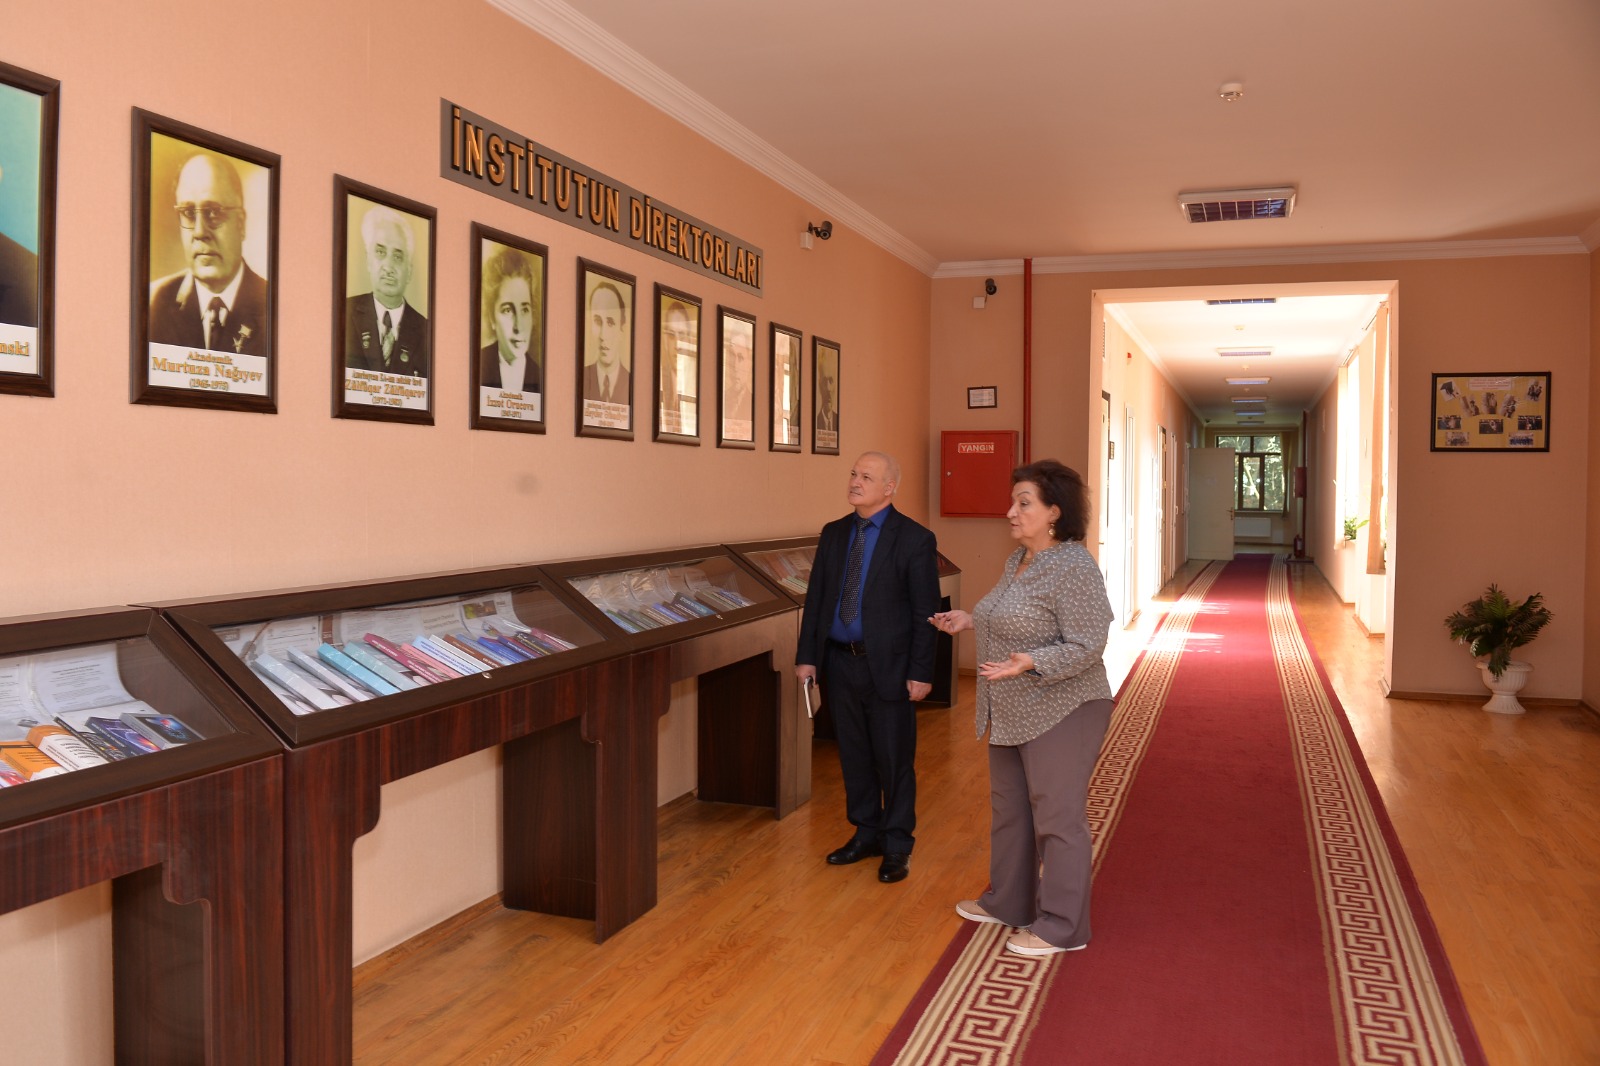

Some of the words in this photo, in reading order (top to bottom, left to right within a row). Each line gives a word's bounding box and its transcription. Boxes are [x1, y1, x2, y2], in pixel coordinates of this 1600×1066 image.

[450, 103, 620, 233] İNSTİTUTUN
[629, 192, 763, 290] DİREKTORLARI
[186, 351, 233, 365] Akademik
[151, 356, 211, 376] Murtuza
[214, 364, 263, 383] Nağıyev
[961, 443, 995, 452] YANGIN
